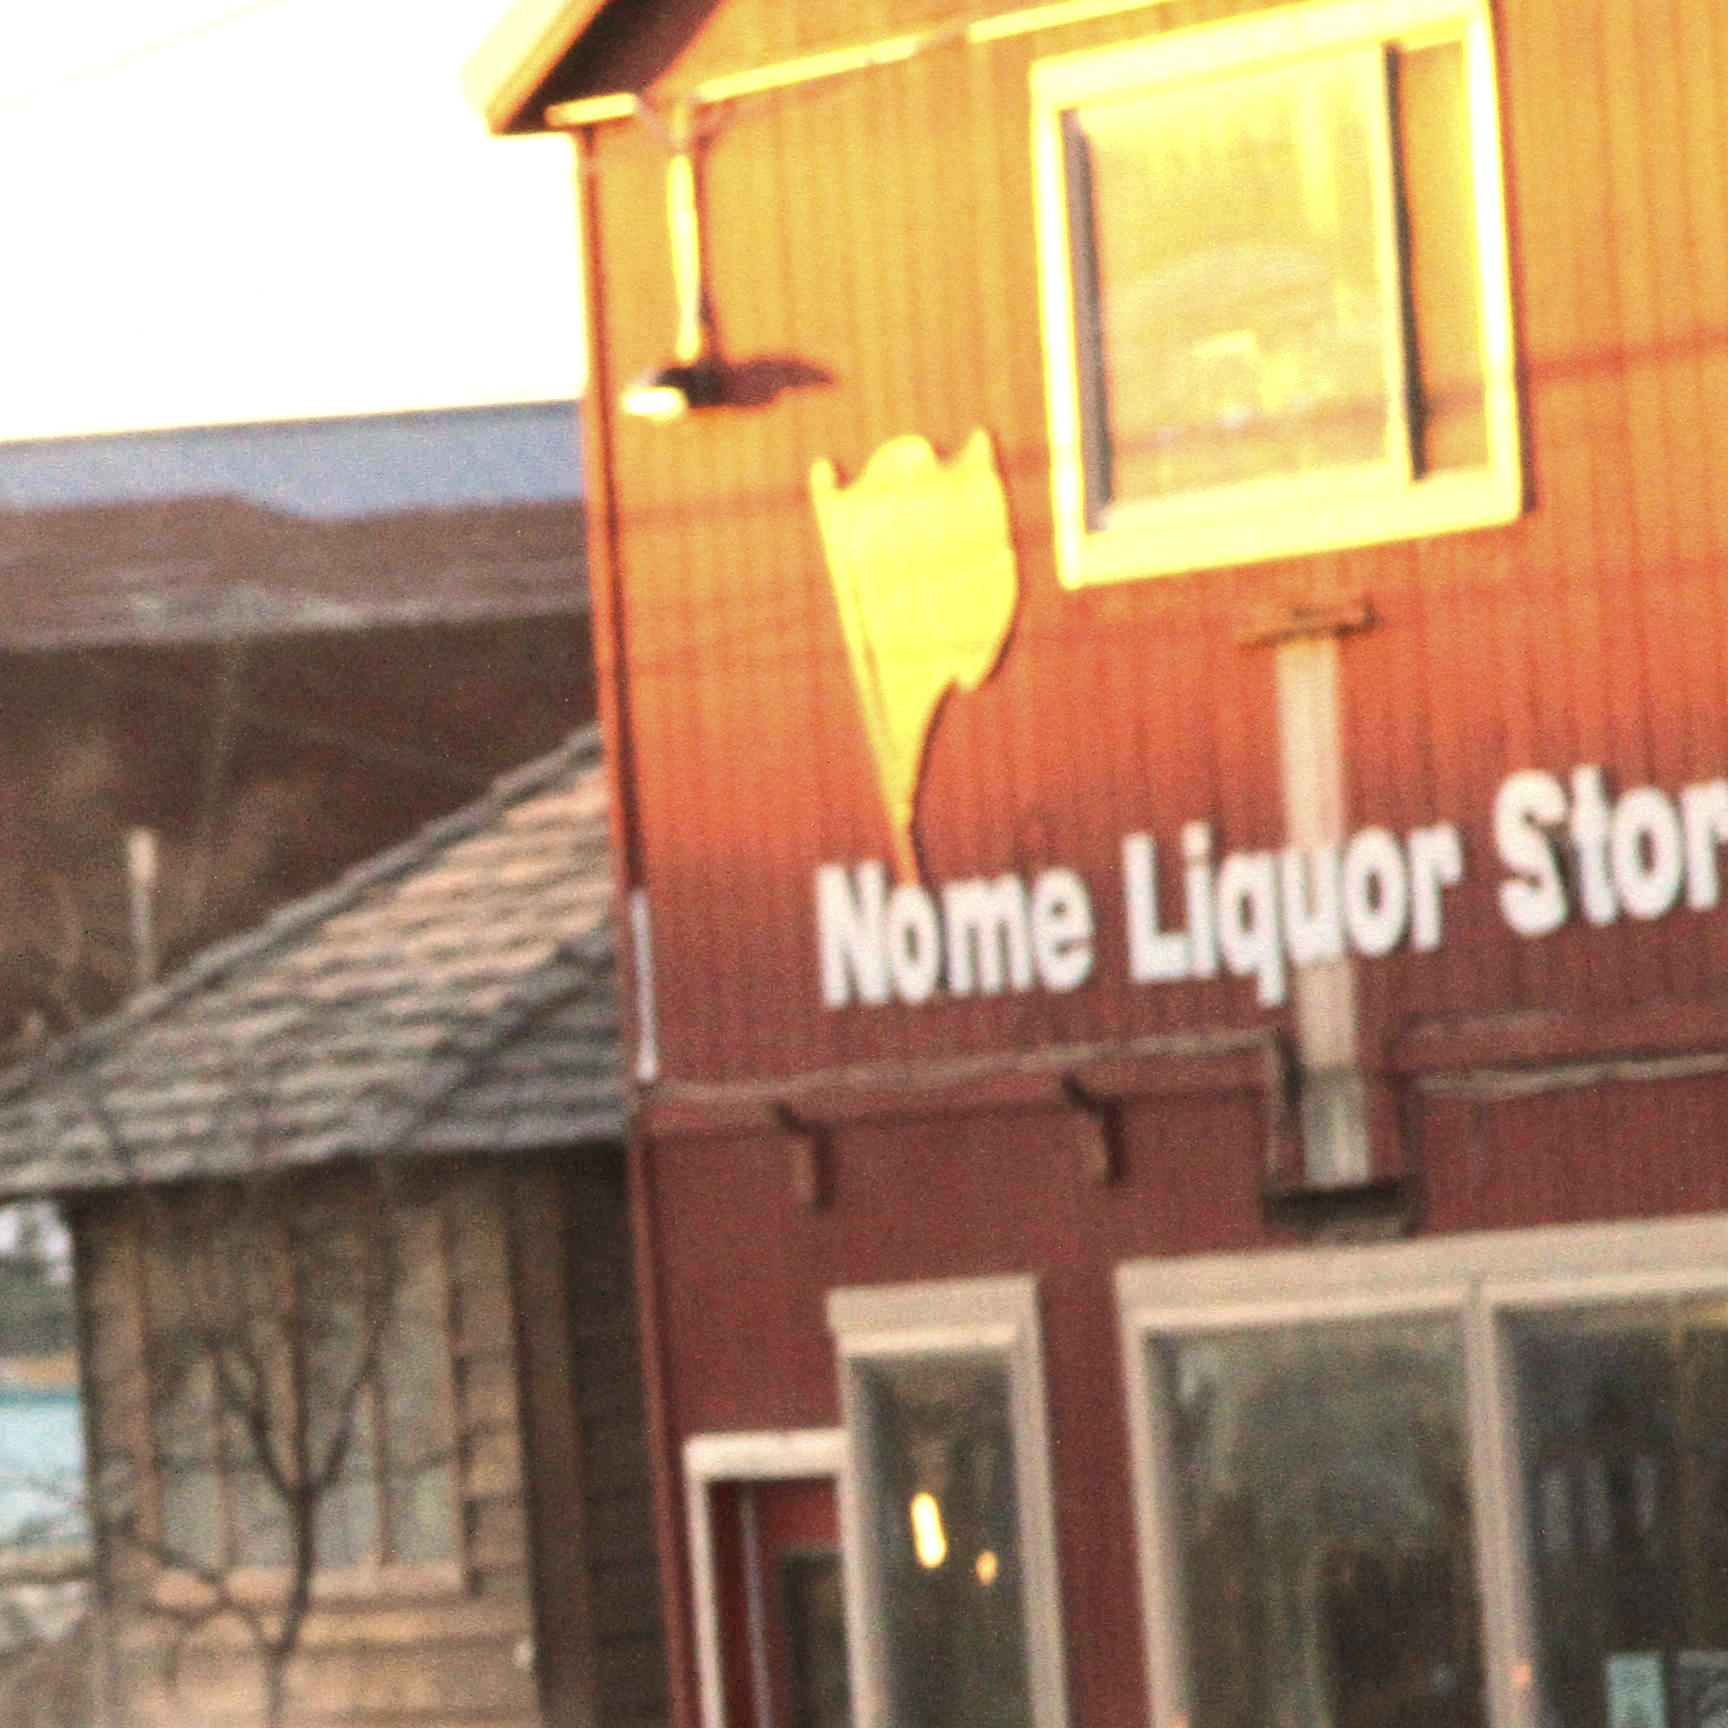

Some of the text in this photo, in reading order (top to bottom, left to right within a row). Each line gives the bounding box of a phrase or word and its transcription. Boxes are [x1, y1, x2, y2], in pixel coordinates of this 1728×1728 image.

[815, 763, 1728, 1010] Nome Liquor Stor
